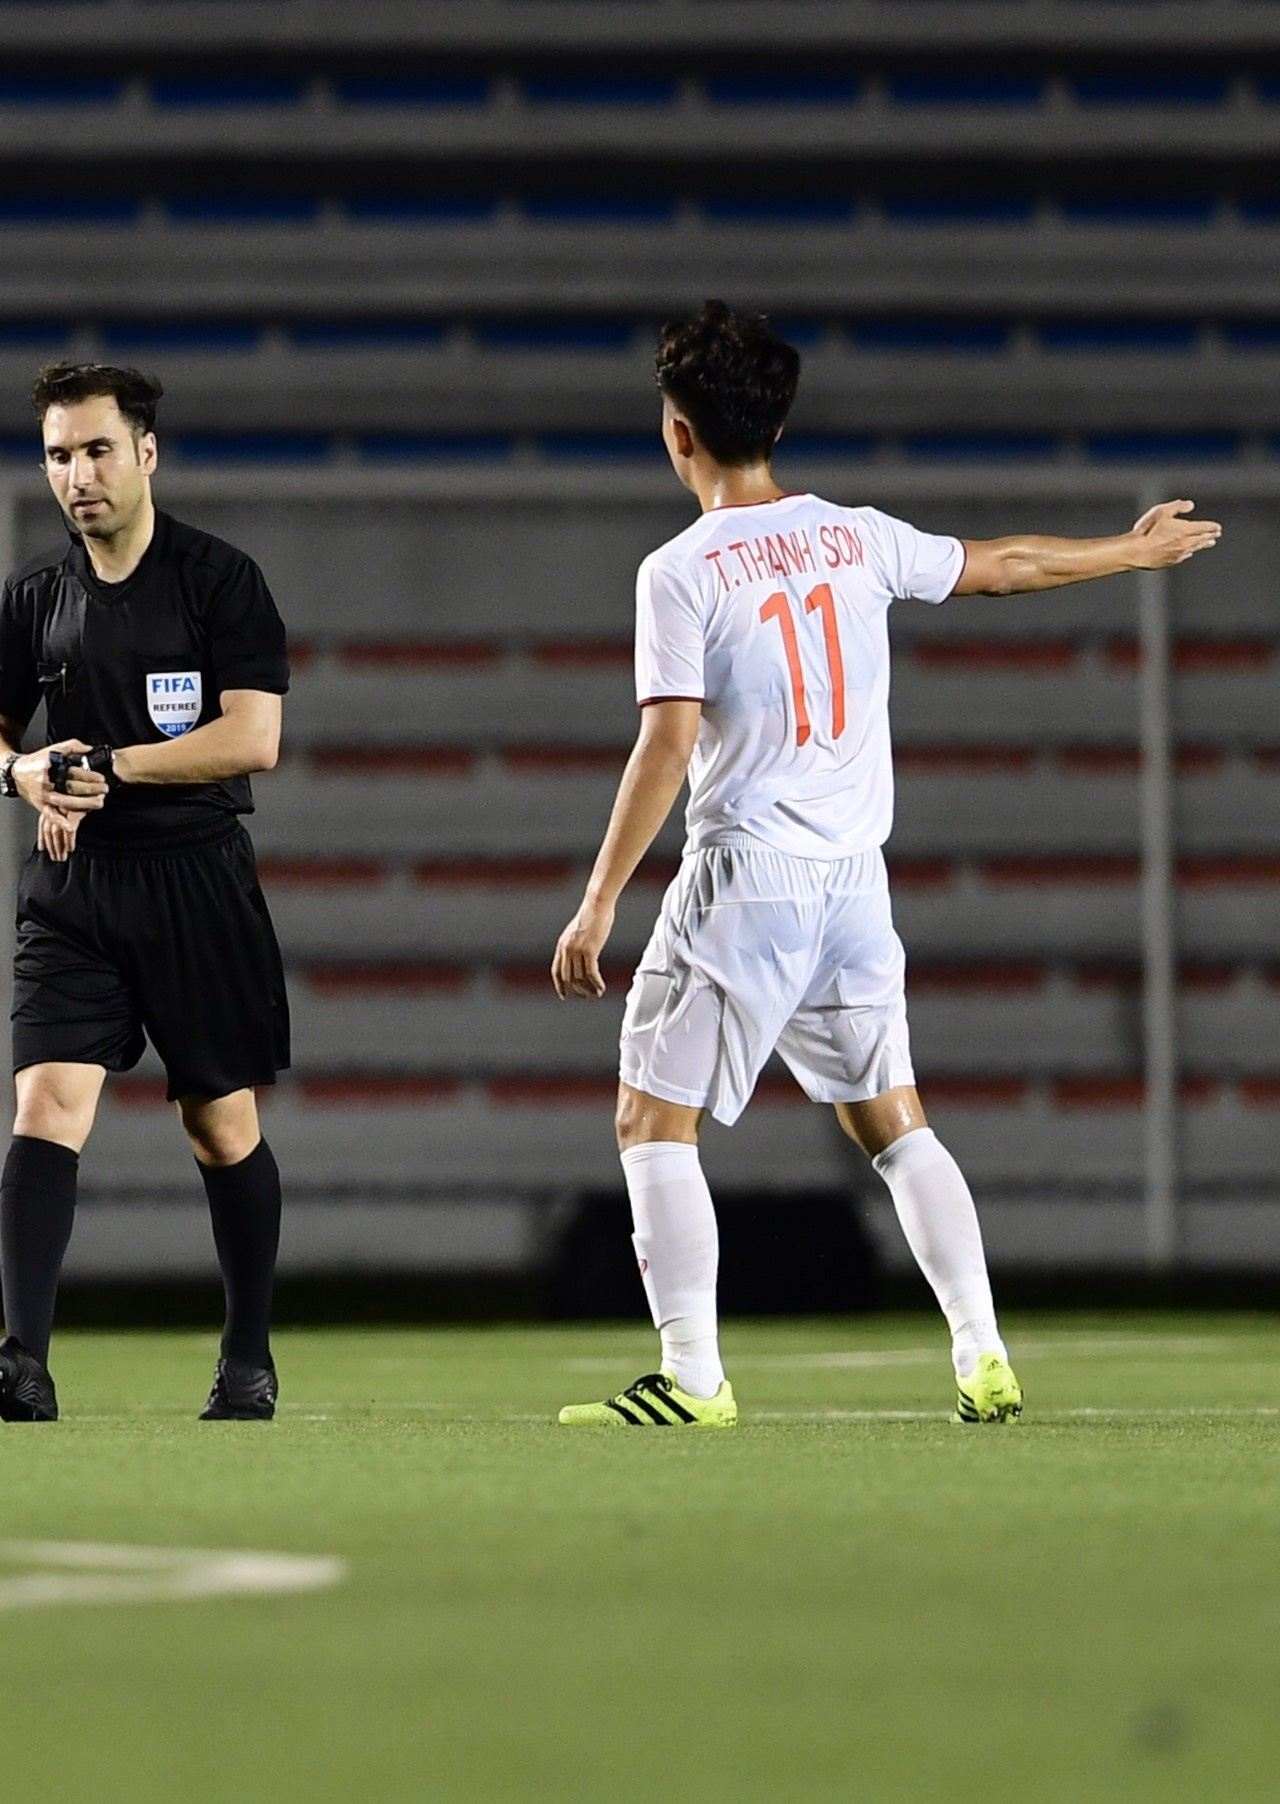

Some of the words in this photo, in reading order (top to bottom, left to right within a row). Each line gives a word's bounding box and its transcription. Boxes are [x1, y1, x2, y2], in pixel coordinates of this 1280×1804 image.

[705, 529, 817, 592] T.THANH
[819, 525, 865, 568] SON
[759, 583, 846, 747] 11
[152, 677, 195, 693] FIFA
[153, 702, 197, 712] REFEREE
[166, 724, 187, 732] 2019
